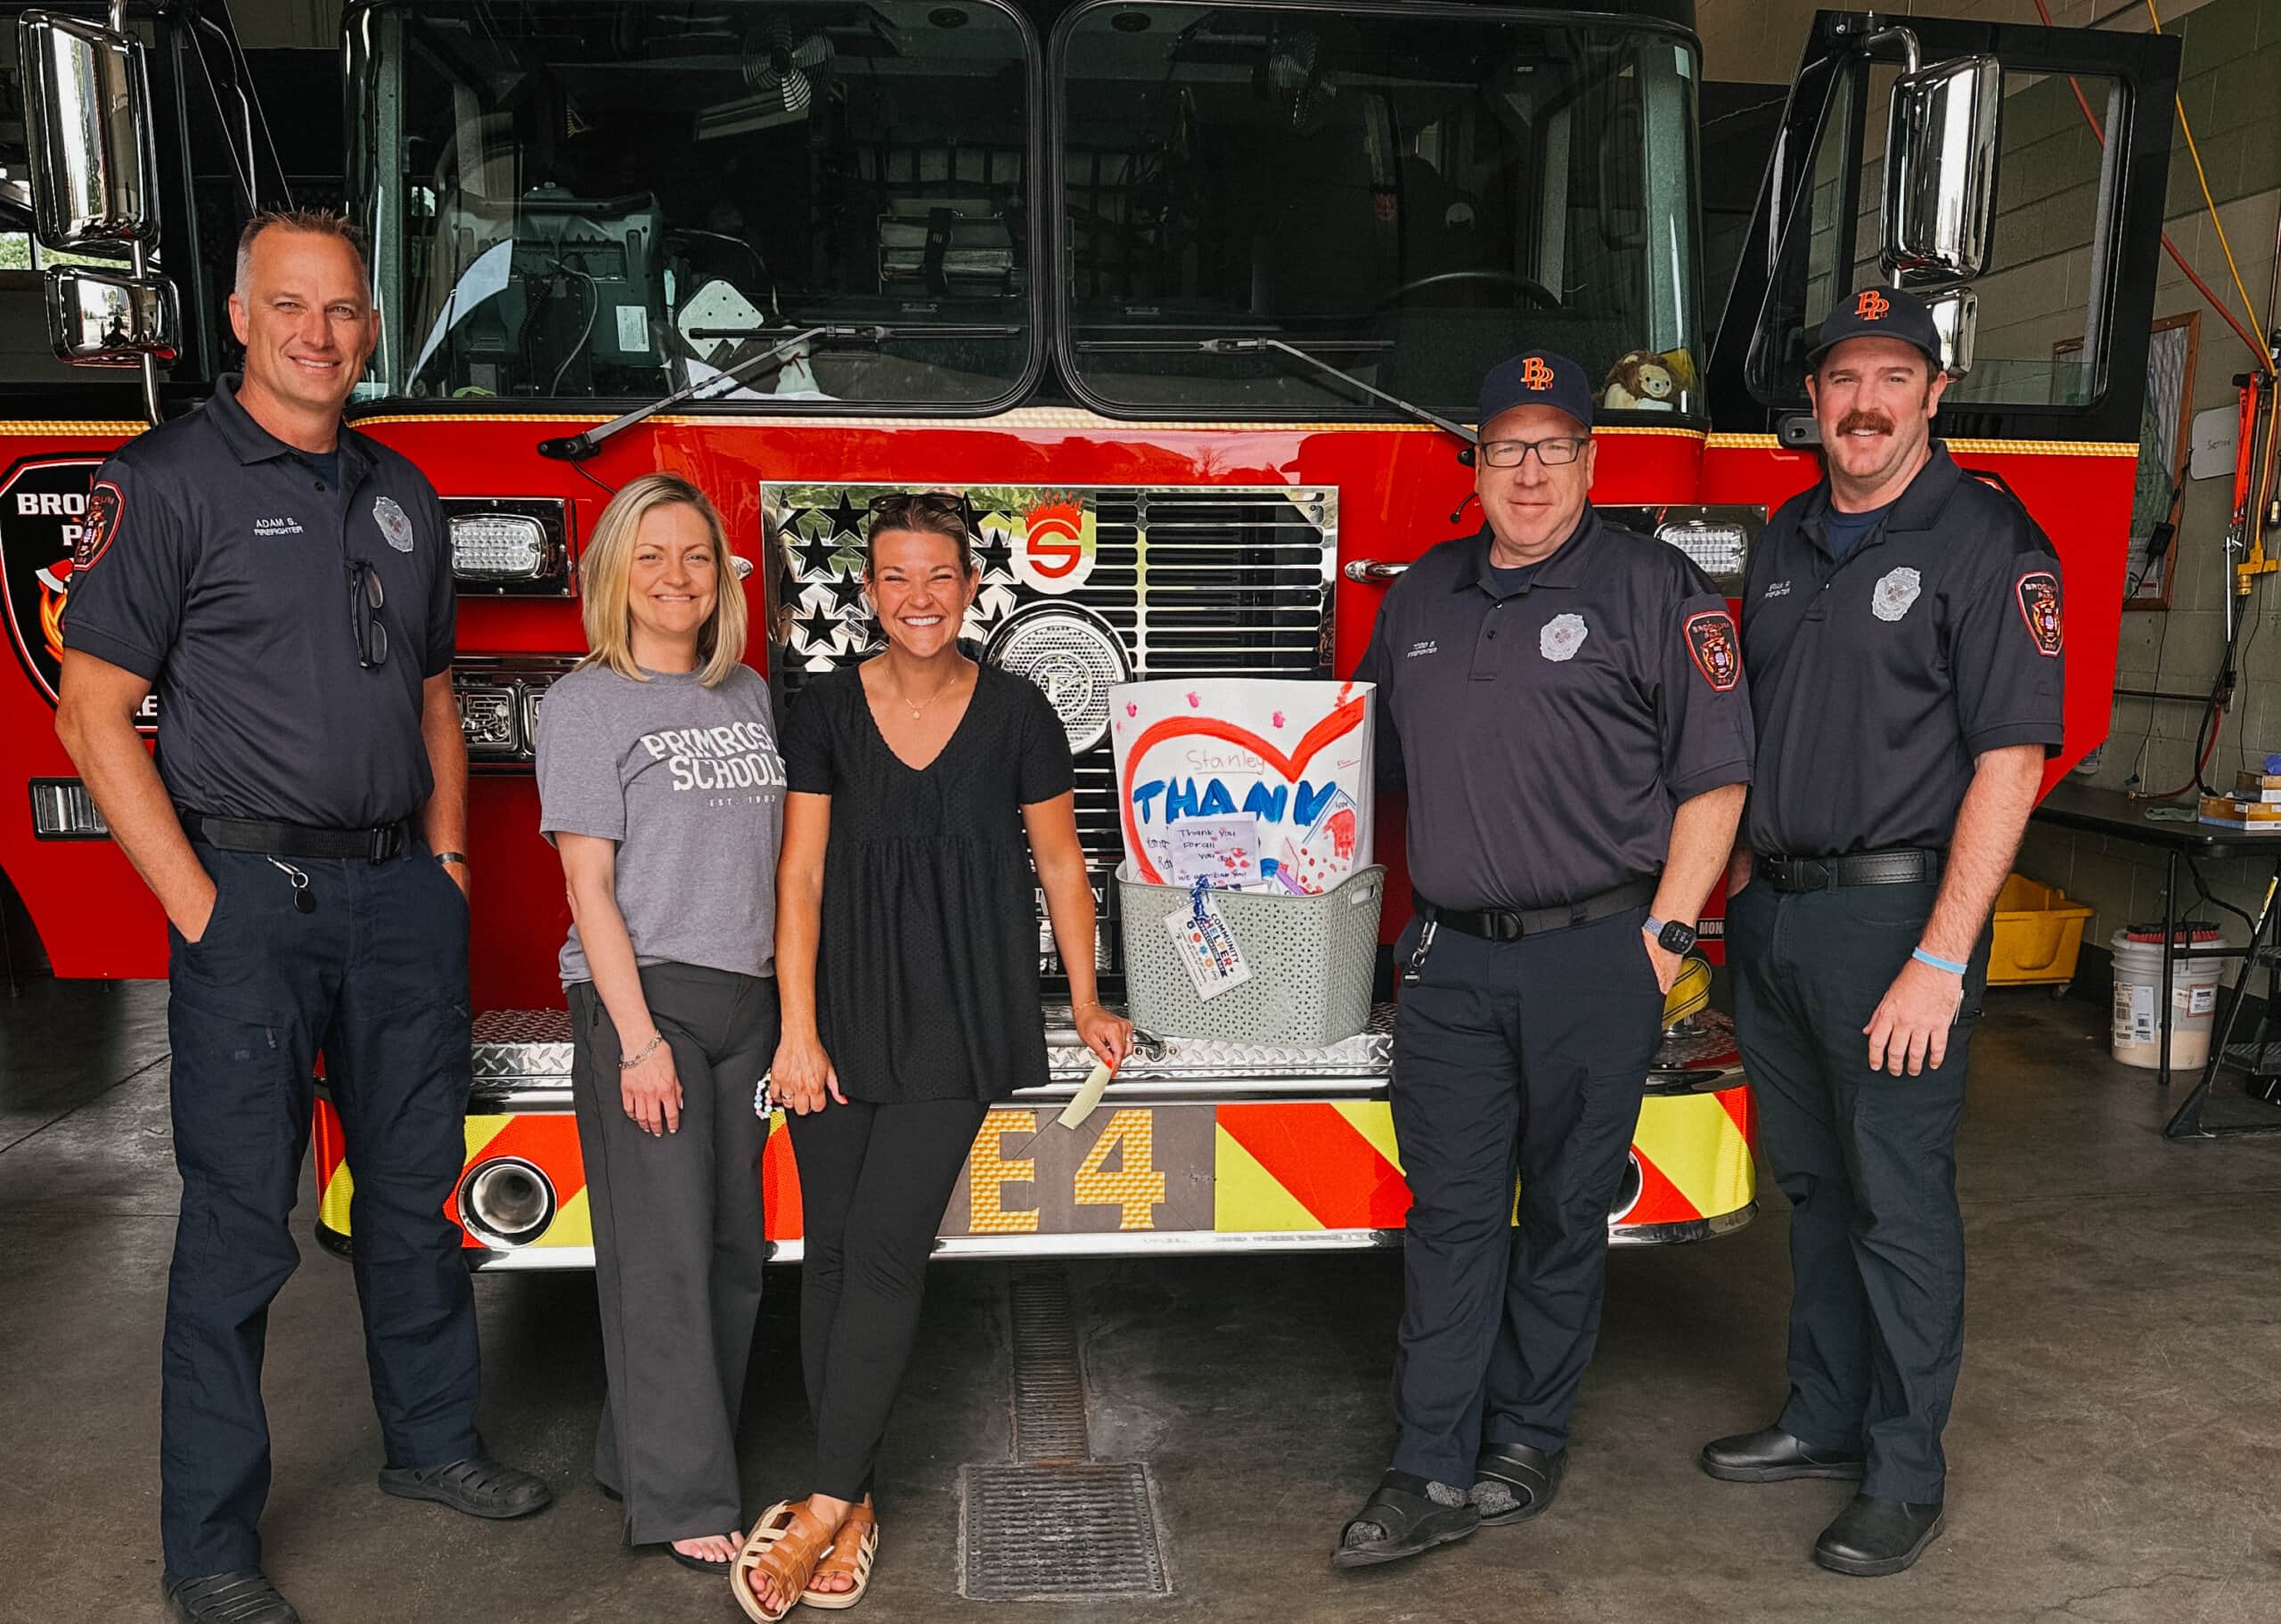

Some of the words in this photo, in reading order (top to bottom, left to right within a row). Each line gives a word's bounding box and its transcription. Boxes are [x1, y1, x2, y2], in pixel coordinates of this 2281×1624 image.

[16, 493, 92, 516] BRO
[256, 518, 285, 528] ADAM
[286, 517, 298, 526] S.
[1186, 748, 1265, 775] Stanley
[1133, 777, 1337, 827] THANK
[1177, 828, 1213, 837] Thank
[1211, 913, 1239, 963] COMMUNITY
[1698, 921, 1725, 934] MON
[1205, 919, 1232, 967] HELPER
[969, 1111, 1041, 1233] E
[1075, 1109, 1165, 1229] 4
